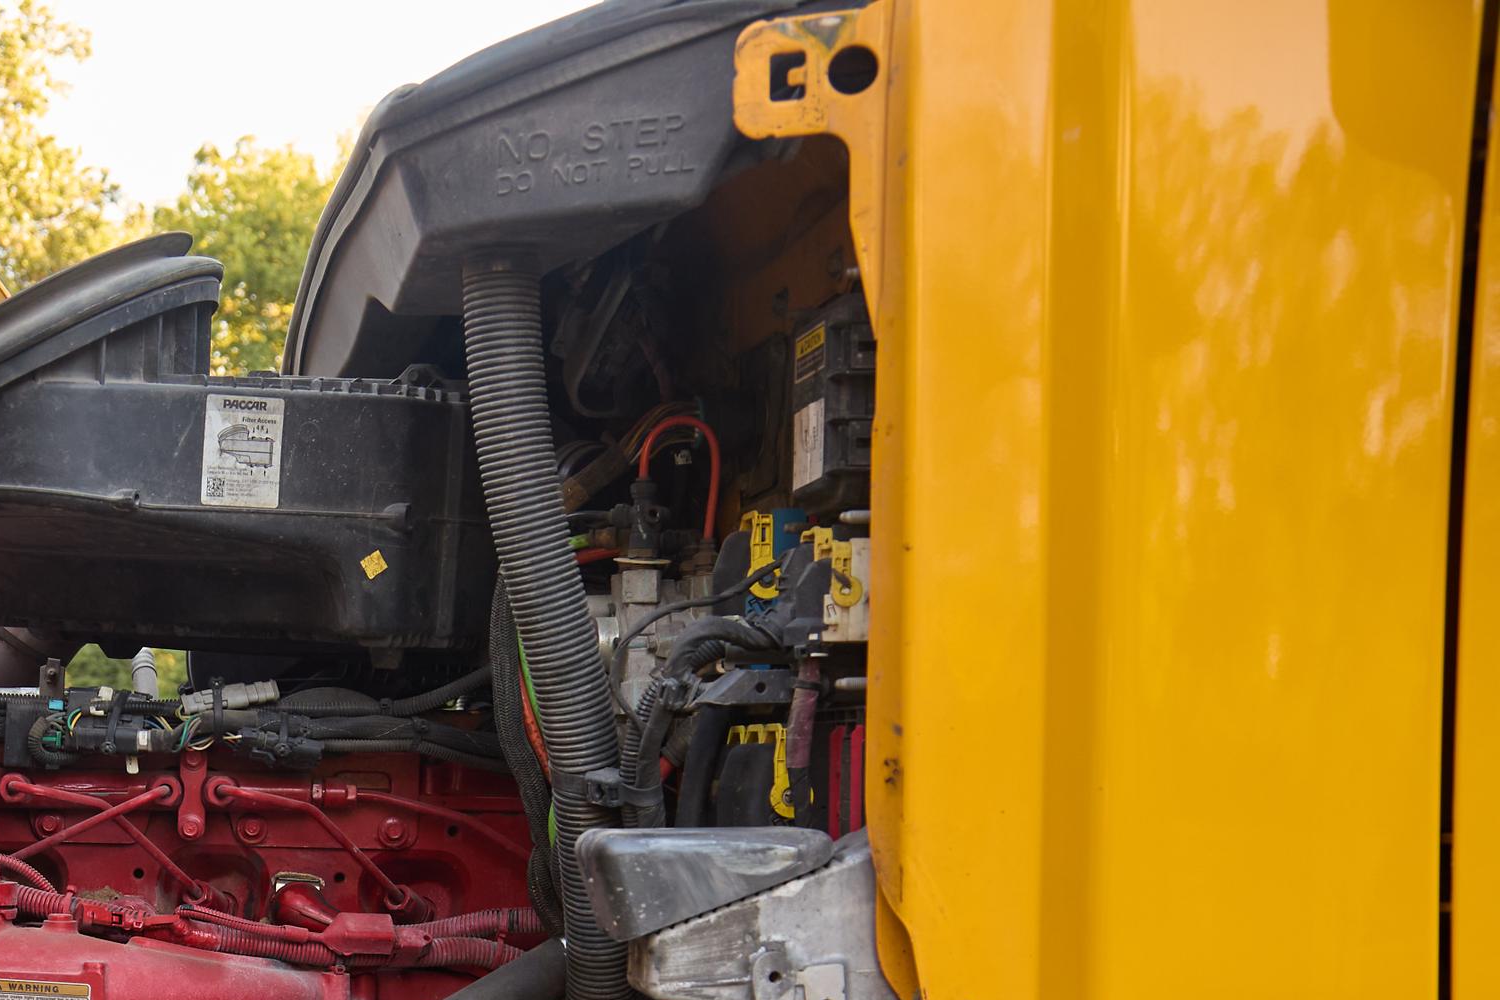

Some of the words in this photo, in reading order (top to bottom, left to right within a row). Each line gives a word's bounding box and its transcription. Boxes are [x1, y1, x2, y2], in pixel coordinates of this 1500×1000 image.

[498, 131, 550, 165] NO
[583, 114, 686, 153] STEP
[497, 170, 533, 196] DO
[553, 160, 609, 186] NOT
[627, 152, 695, 178] PULL
[223, 399, 268, 411] PACCAR
[242, 416, 257, 424] Filter
[257, 417, 277, 425] Access
[8, 983, 60, 994] WARNING
